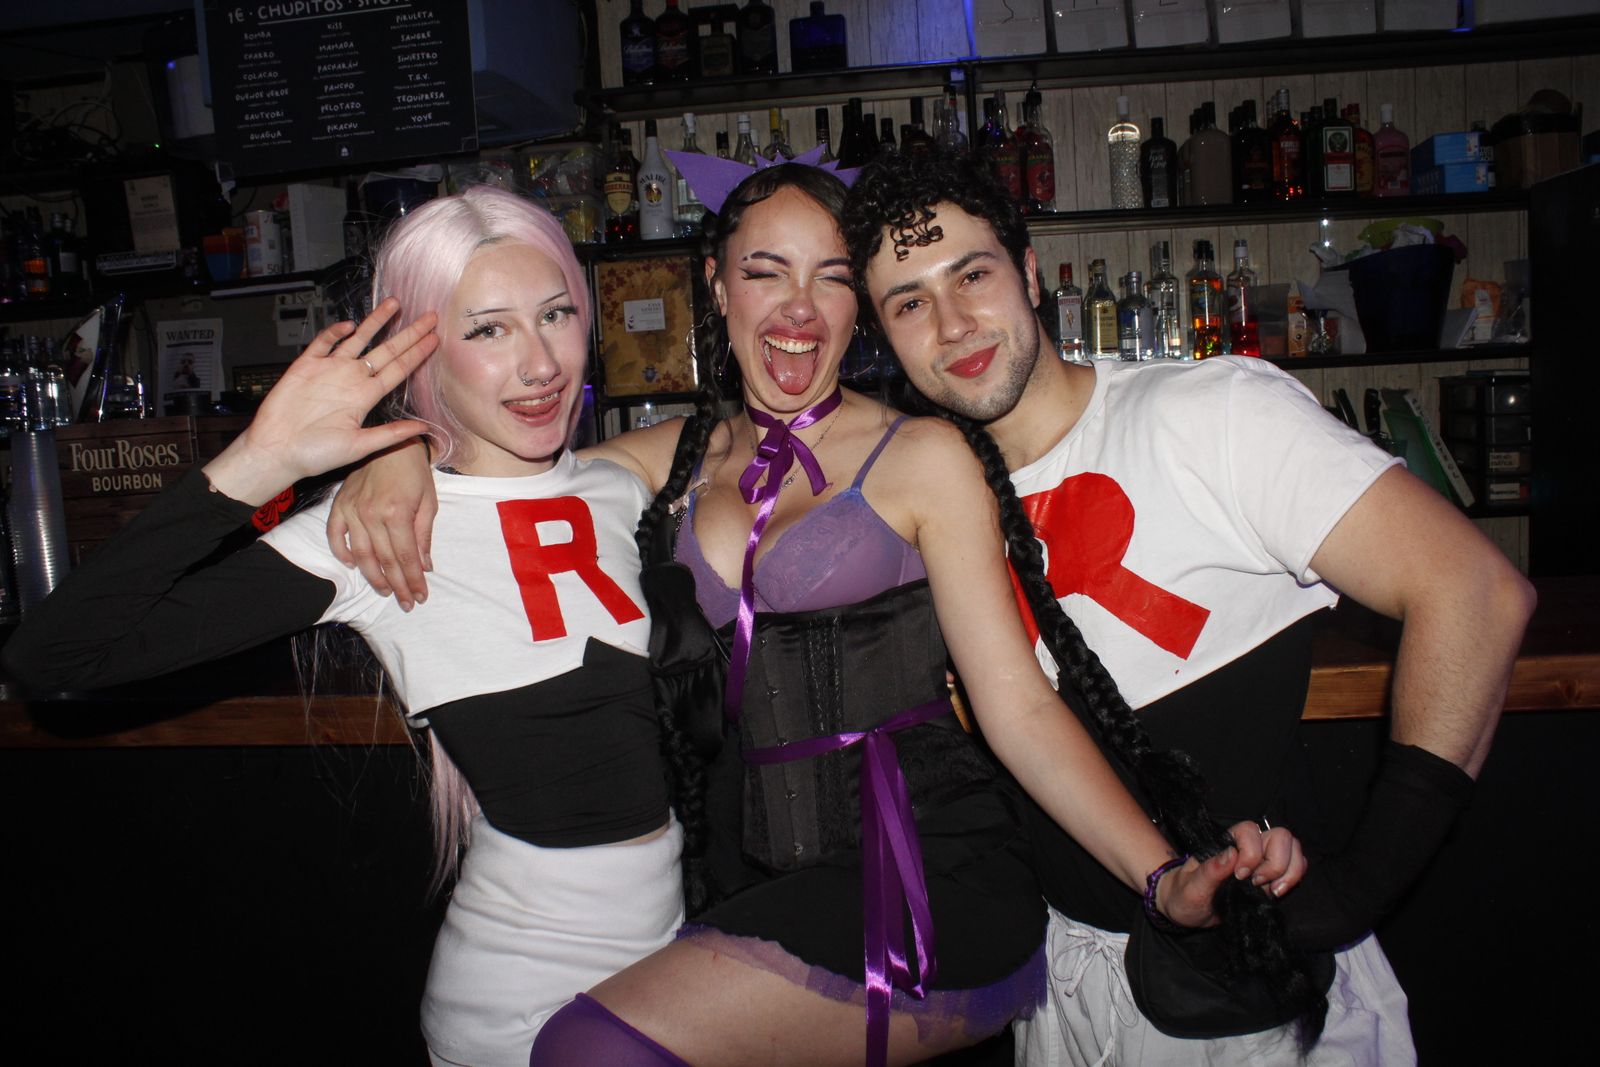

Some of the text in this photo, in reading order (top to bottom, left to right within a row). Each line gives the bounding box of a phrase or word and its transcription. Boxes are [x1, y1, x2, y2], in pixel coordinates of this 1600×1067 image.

[257, 0, 343, 20] CHUPITOS
[396, 11, 434, 23] PIRULETA
[243, 31, 272, 41] BOMBA
[400, 31, 432, 42] SANGRE
[319, 41, 354, 52] MAMADA
[243, 51, 276, 61] CHARRO
[397, 52, 438, 63] SINIESTRO
[242, 71, 279, 81] COLACAO
[323, 82, 355, 93] PANCHO
[396, 91, 445, 103] TEQUIFRESA
[320, 101, 362, 114] PELOTAZO
[410, 112, 433, 123] YOYE
[327, 122, 359, 133] PIKACHU
[166, 330, 214, 341] WANTED
[69, 439, 180, 472] Four Roses
[91, 473, 162, 492] BOURBON
[496, 496, 645, 641] R
